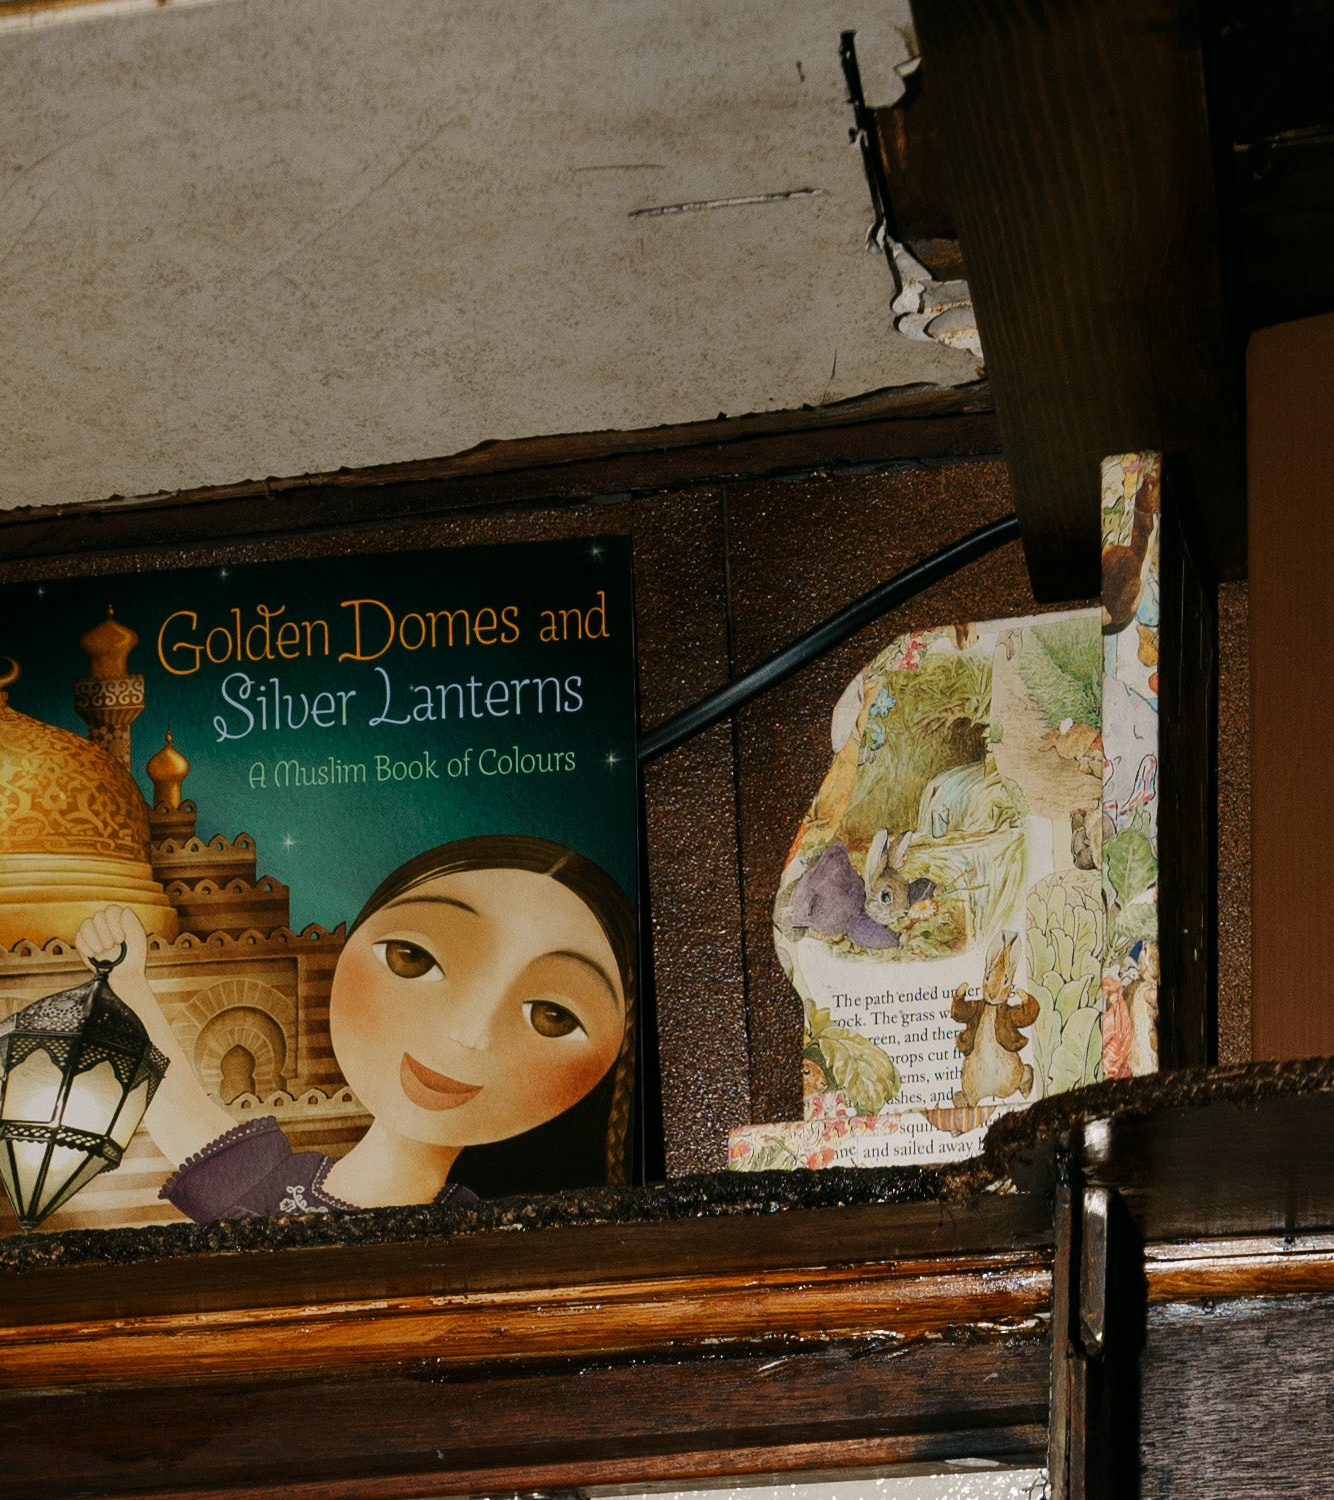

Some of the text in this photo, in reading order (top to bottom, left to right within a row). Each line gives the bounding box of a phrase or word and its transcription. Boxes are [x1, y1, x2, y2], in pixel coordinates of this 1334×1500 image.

[157, 589, 610, 677] Golden Domes and
[213, 665, 585, 743] Silver Lanterns
[248, 746, 578, 789] A Muslim Book of Colours
[832, 987, 939, 1013] The path ended
[871, 1010, 935, 1028] The grass
[893, 1139, 975, 1158] sailed away
